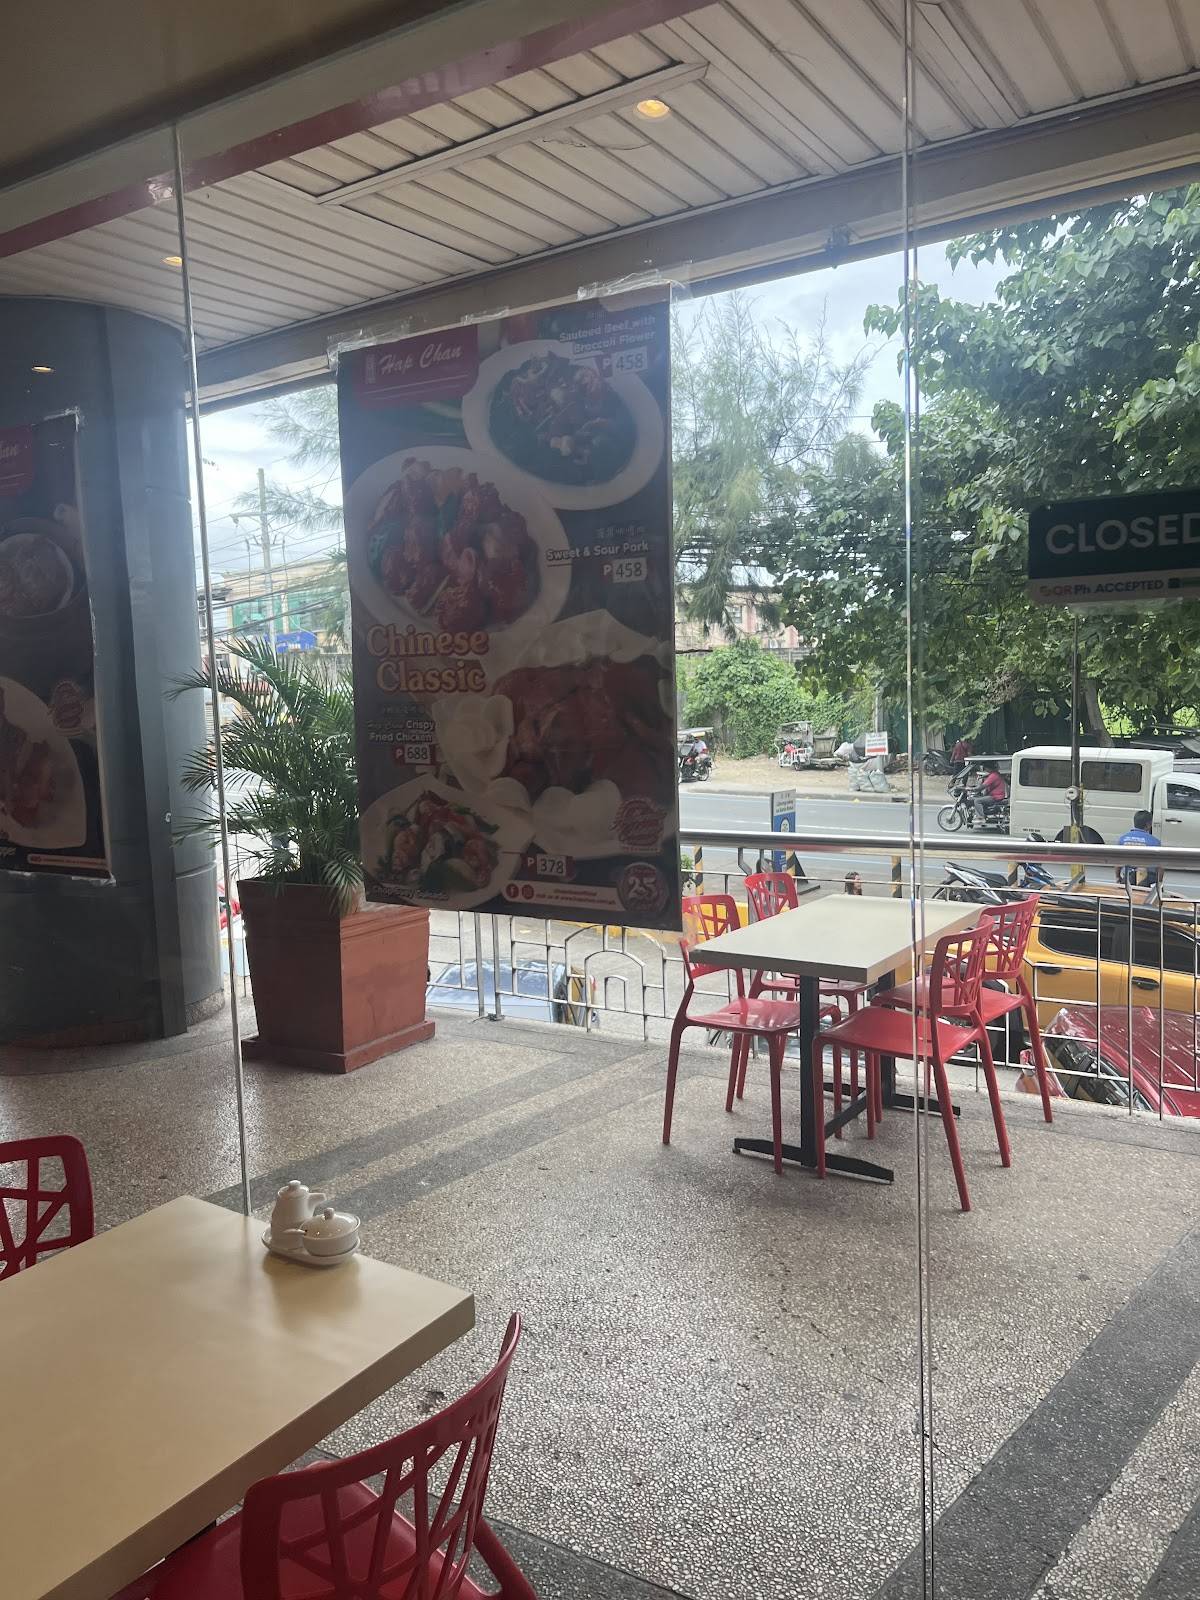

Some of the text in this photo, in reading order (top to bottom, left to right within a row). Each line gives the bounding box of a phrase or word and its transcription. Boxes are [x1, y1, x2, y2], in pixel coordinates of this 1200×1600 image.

[420, 342, 462, 369] Chan
[615, 352, 644, 370] 458
[1046, 512, 1200, 555] CLOSED
[547, 540, 649, 561] Sweet & Sour Pork
[615, 561, 643, 578] 458
[1094, 579, 1165, 594] ACCEPTED
[367, 622, 489, 658] Chinese
[376, 658, 486, 694] Classic
[406, 719, 435, 732] Crispy
[396, 732, 432, 743] Chicken
[406, 746, 429, 760] 688
[540, 858, 564, 874] 378
